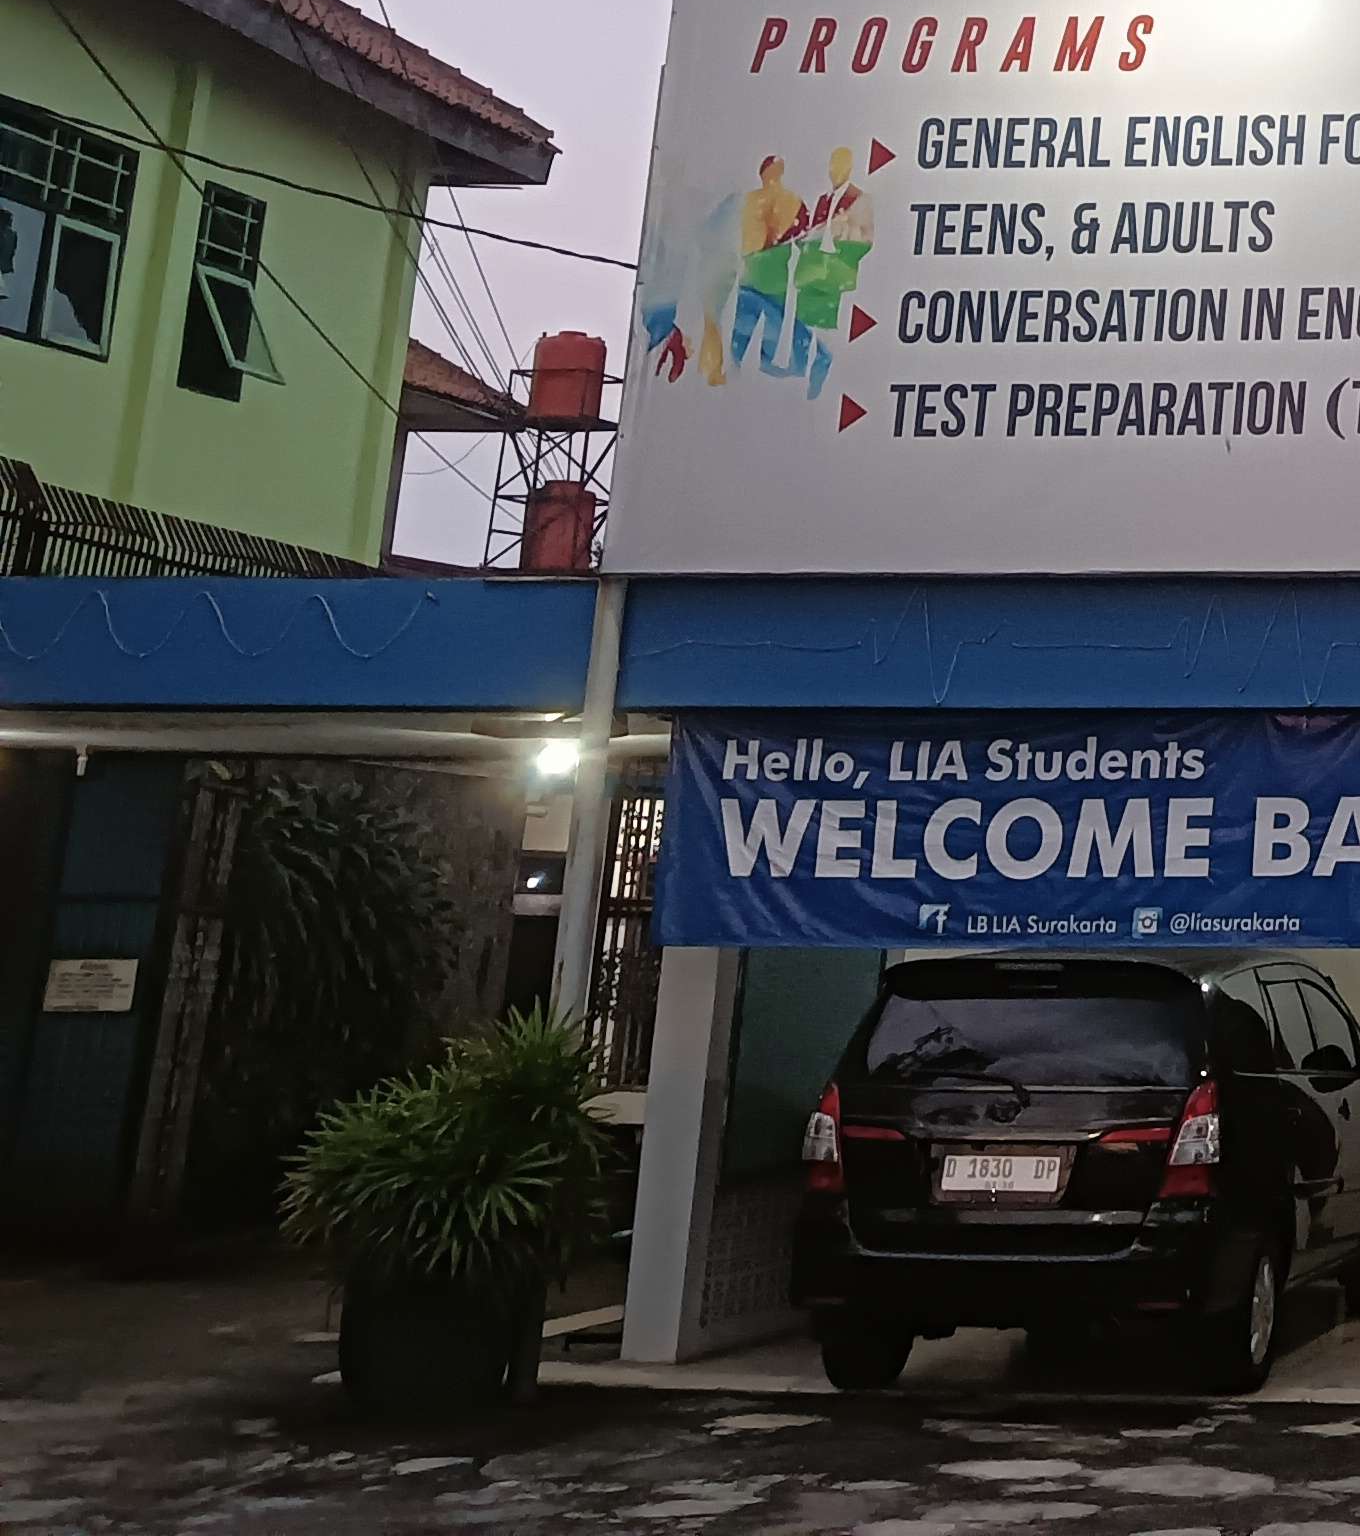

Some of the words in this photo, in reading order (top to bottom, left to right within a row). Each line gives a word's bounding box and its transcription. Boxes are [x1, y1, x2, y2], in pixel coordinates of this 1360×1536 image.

[750, 15, 1154, 74] PROGRAMS
[917, 116, 1110, 169] GENERAL
[1125, 114, 1306, 167] ENGLISH
[909, 202, 1054, 262] TEENS,
[1070, 202, 1100, 255] &
[1110, 200, 1275, 255] ADULTS
[898, 288, 1225, 344] CONVERSATION
[1239, 287, 1285, 342] IN
[890, 382, 996, 438] TEST
[1006, 380, 1307, 438] PREPARATION
[720, 737, 870, 790] Hello,
[888, 739, 969, 782] LIA
[984, 735, 1207, 782] Students
[720, 797, 1215, 882] WELCOME
[967, 915, 989, 935] LB
[992, 915, 1021, 935] LIA
[1026, 914, 1117, 936] Surakarta
[1169, 912, 1301, 937] @liasurakarta
[945, 1157, 957, 1178] D
[967, 1158, 1013, 1179] 1830
[1033, 1158, 1057, 1180] DP
